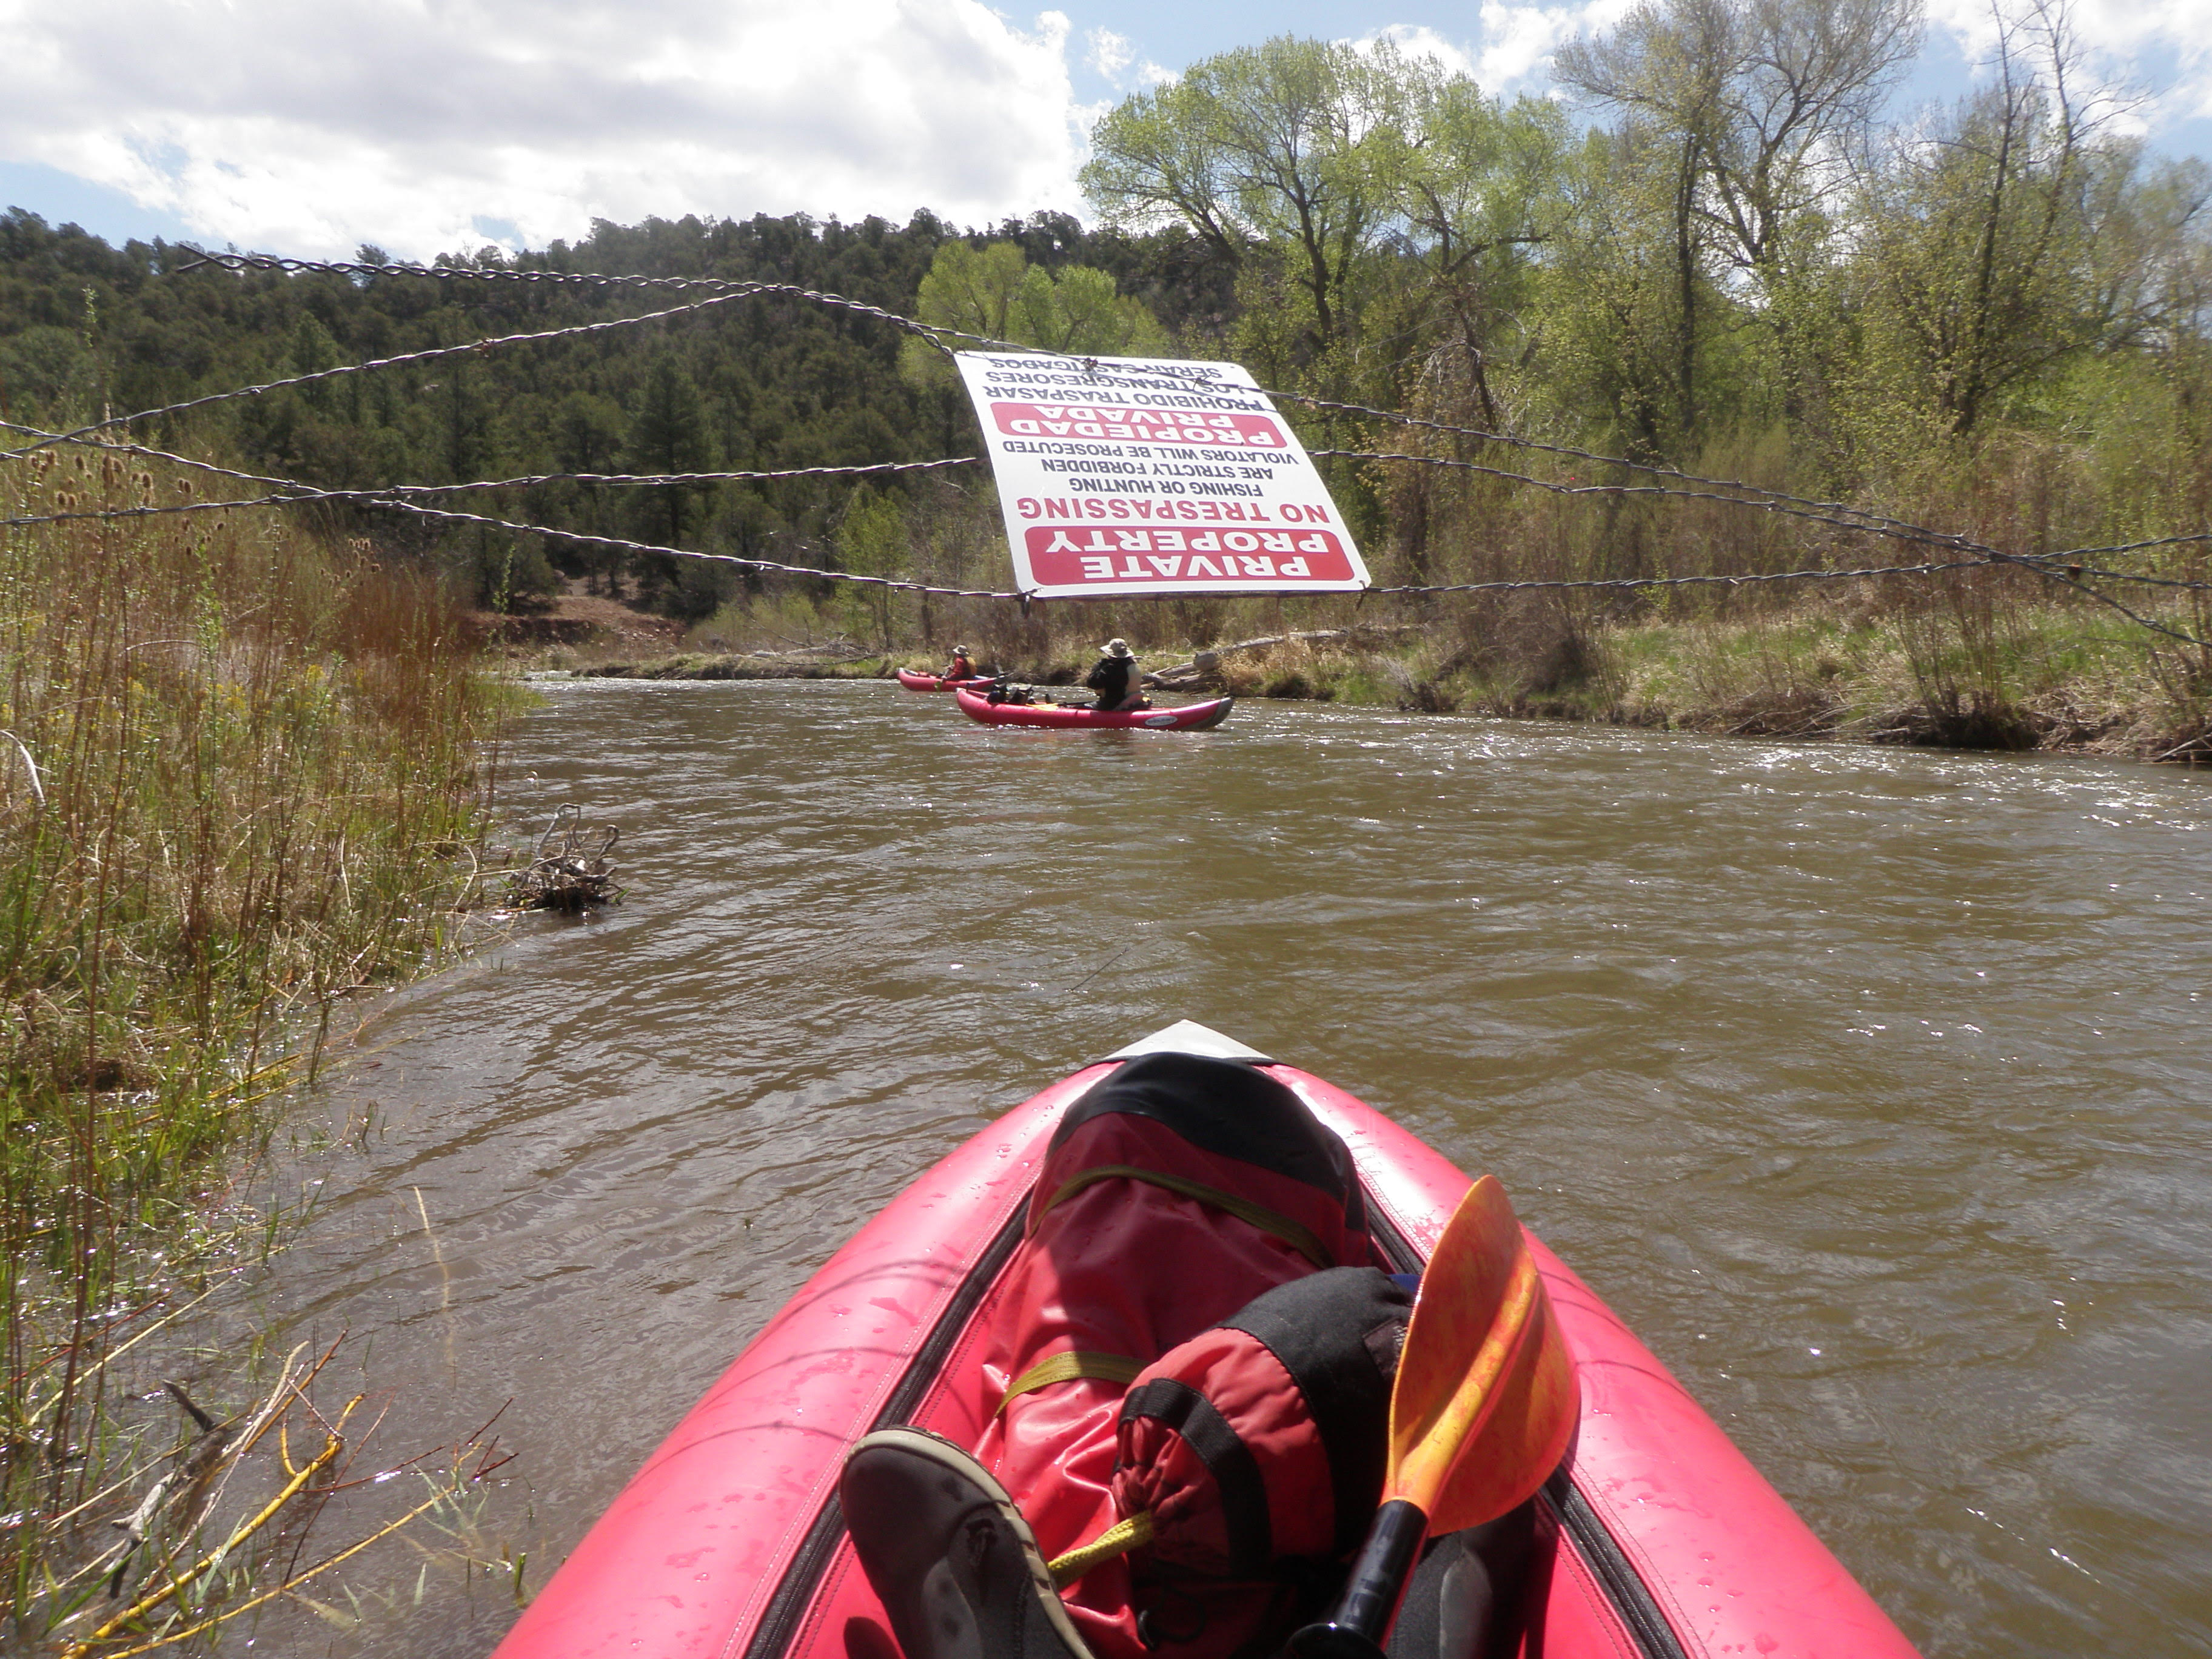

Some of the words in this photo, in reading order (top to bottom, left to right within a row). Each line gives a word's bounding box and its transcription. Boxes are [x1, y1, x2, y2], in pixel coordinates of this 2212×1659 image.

[985, 371, 1194, 392] TRANSGRESORES
[982, 386, 1130, 404] TRASPASAR
[1133, 393, 1265, 411] PROHIBIDO
[1033, 405, 1235, 428] PRIVADA
[1010, 419, 1276, 445] PROPIEDAD
[1002, 441, 1124, 457] PROSECUTED
[1126, 446, 1152, 458] BE
[1153, 447, 1199, 460] WILL
[1201, 449, 1299, 464] VIOLATORS
[1041, 459, 1147, 474] FORBIDDEN
[1153, 463, 1236, 478] STRICTLY
[1238, 466, 1273, 480] ARE
[1069, 478, 1156, 493] HUNTING
[1158, 480, 1185, 494] OR
[1189, 481, 1264, 497] FISHING
[1017, 497, 1271, 521] TRESPASSING
[1279, 503, 1330, 523] NO
[1045, 531, 1329, 553] PROPERTY
[1079, 555, 1312, 578] PRIVATE
